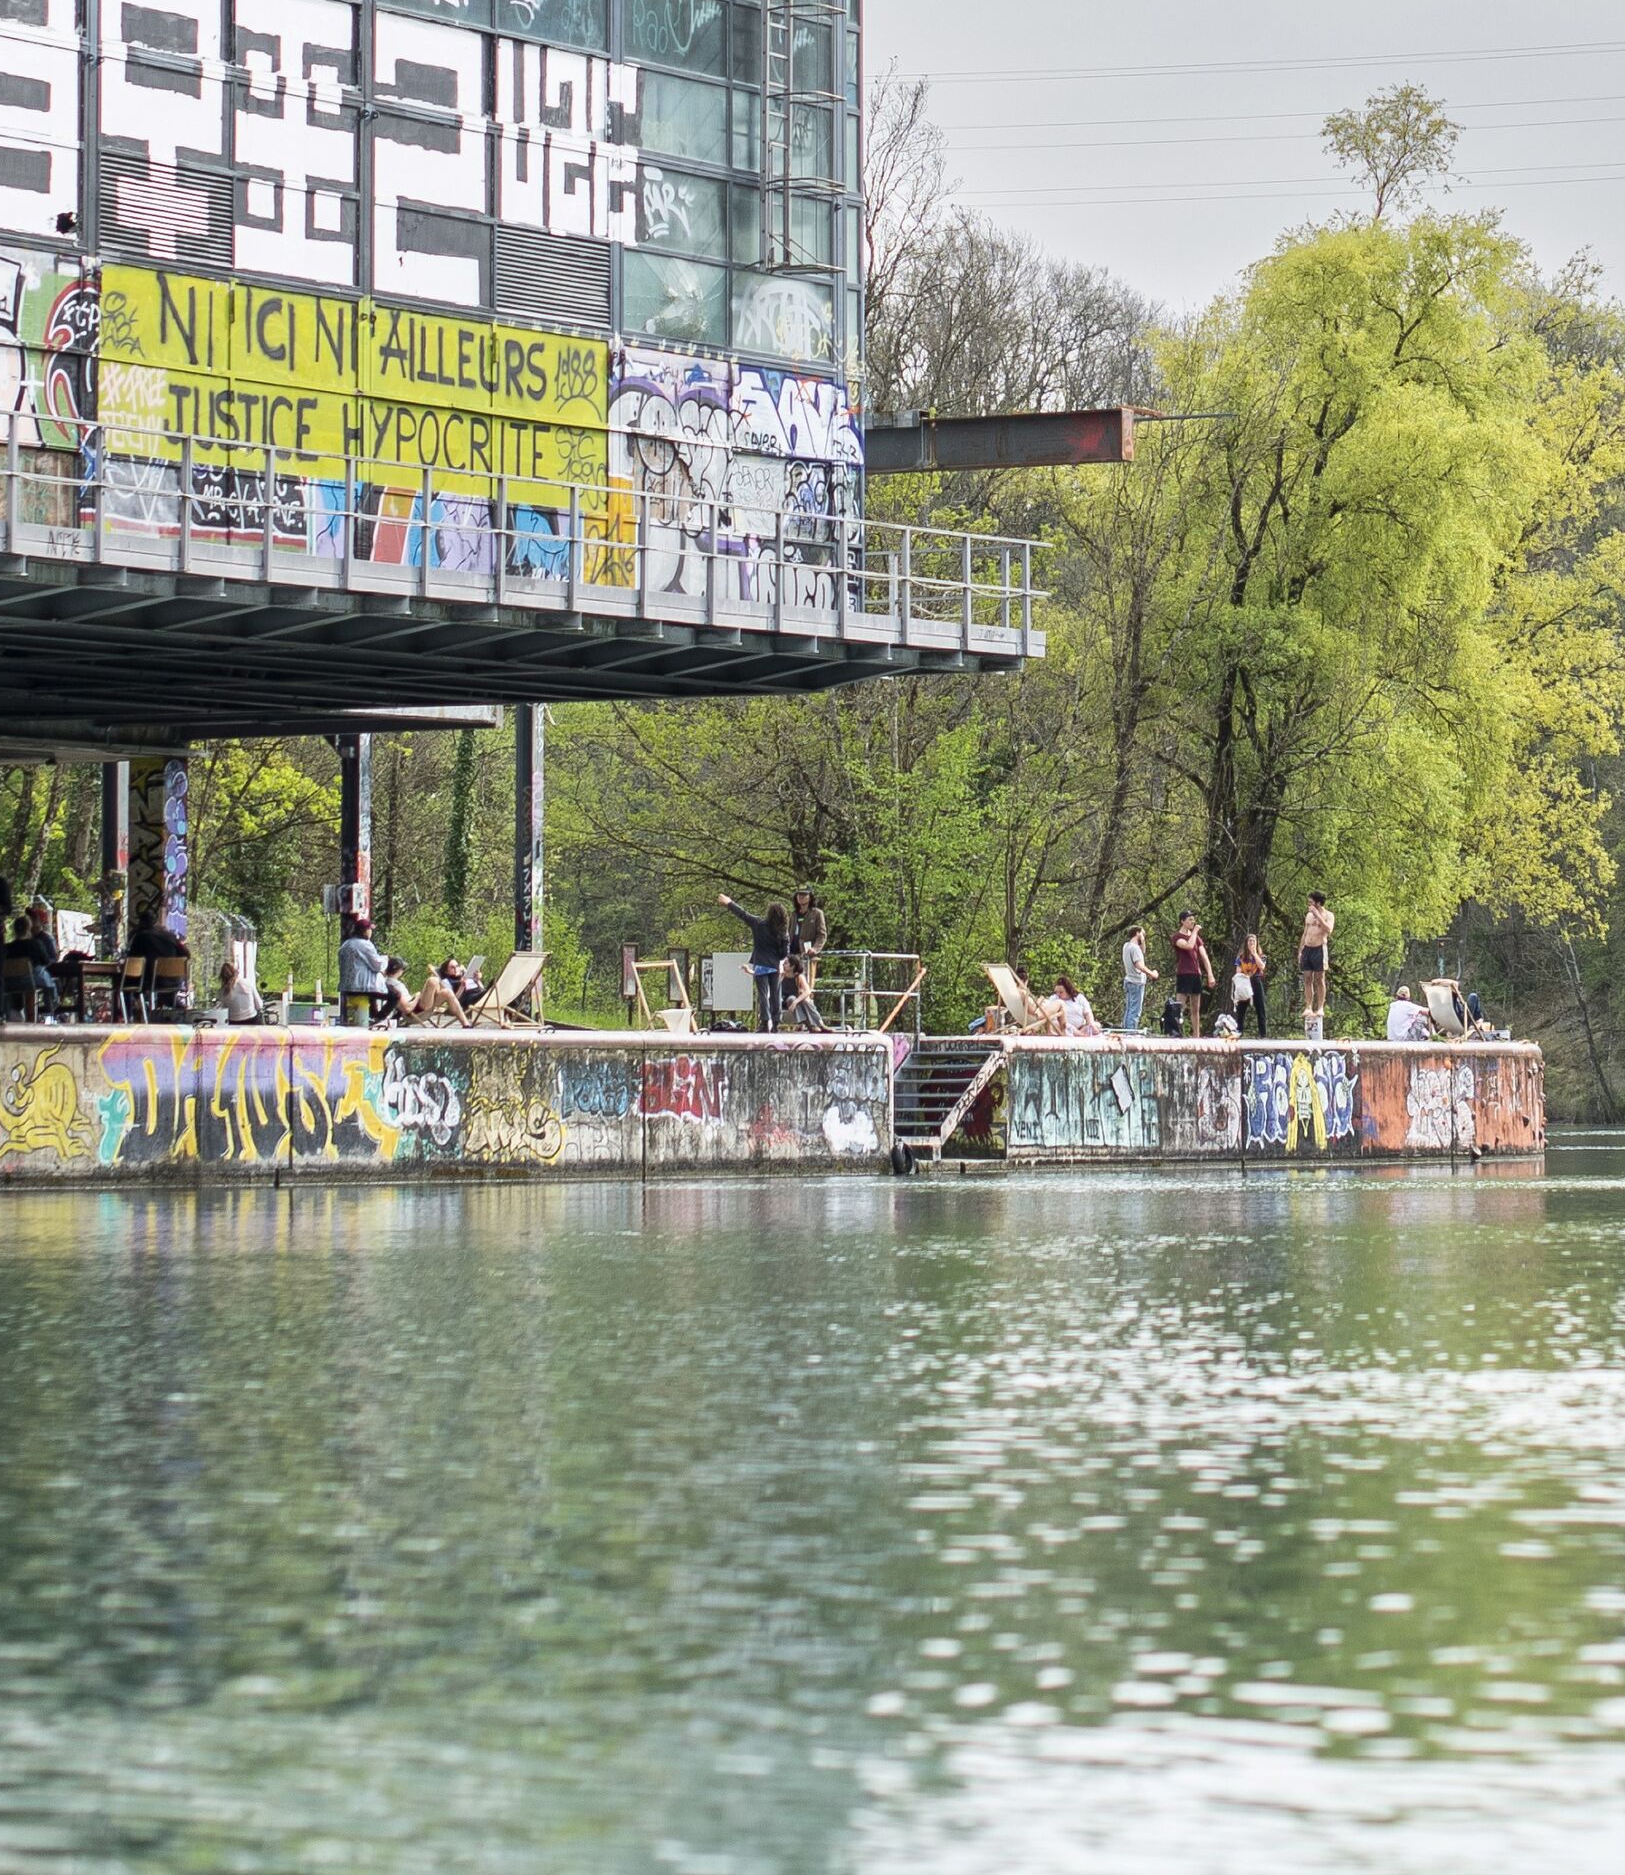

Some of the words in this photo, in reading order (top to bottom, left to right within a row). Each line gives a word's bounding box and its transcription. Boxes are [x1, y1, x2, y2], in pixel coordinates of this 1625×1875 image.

[156, 271, 214, 369] NI
[245, 285, 295, 372] ICI
[164, 383, 319, 463] JUSTICE
[342, 401, 552, 480] HYPOCRITE
